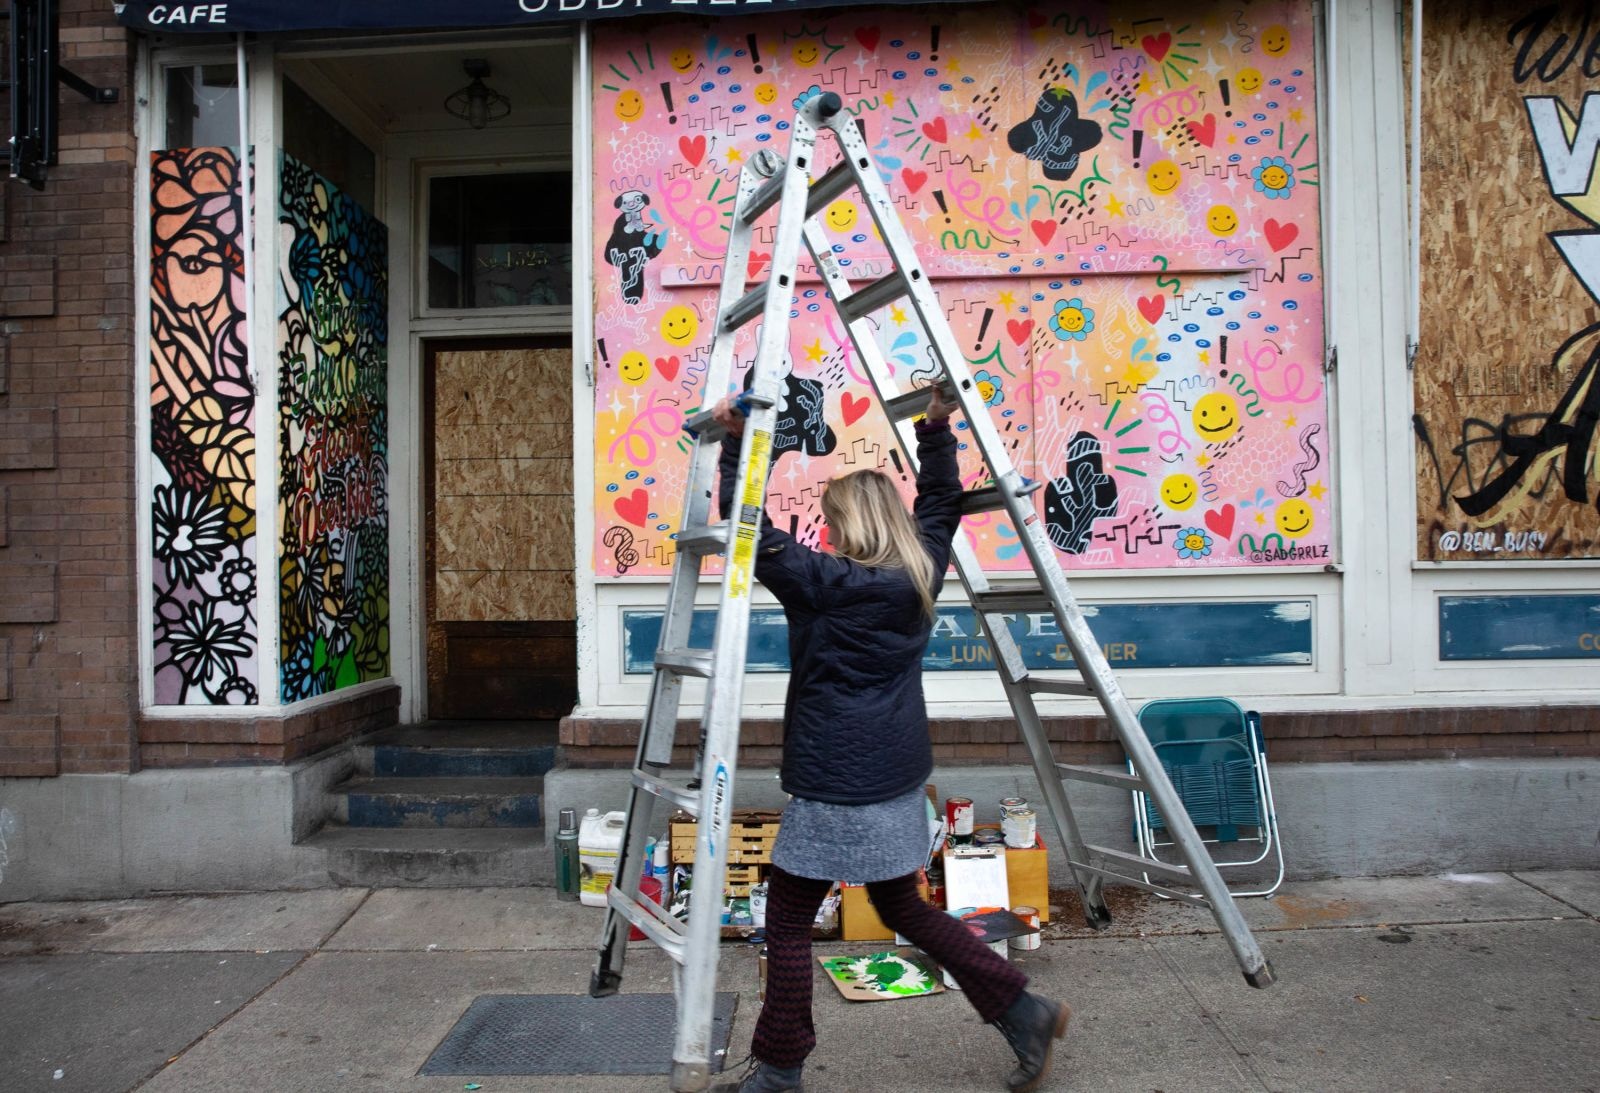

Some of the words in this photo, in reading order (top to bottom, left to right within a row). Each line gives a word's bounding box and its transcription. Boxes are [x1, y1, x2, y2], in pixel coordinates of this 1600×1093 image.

[148, 4, 228, 24] CAFE
[1439, 531, 1548, 552] @BEN_BUSY
[1250, 545, 1329, 563] @SADGRRLZ
[951, 645, 1022, 663] LUN
